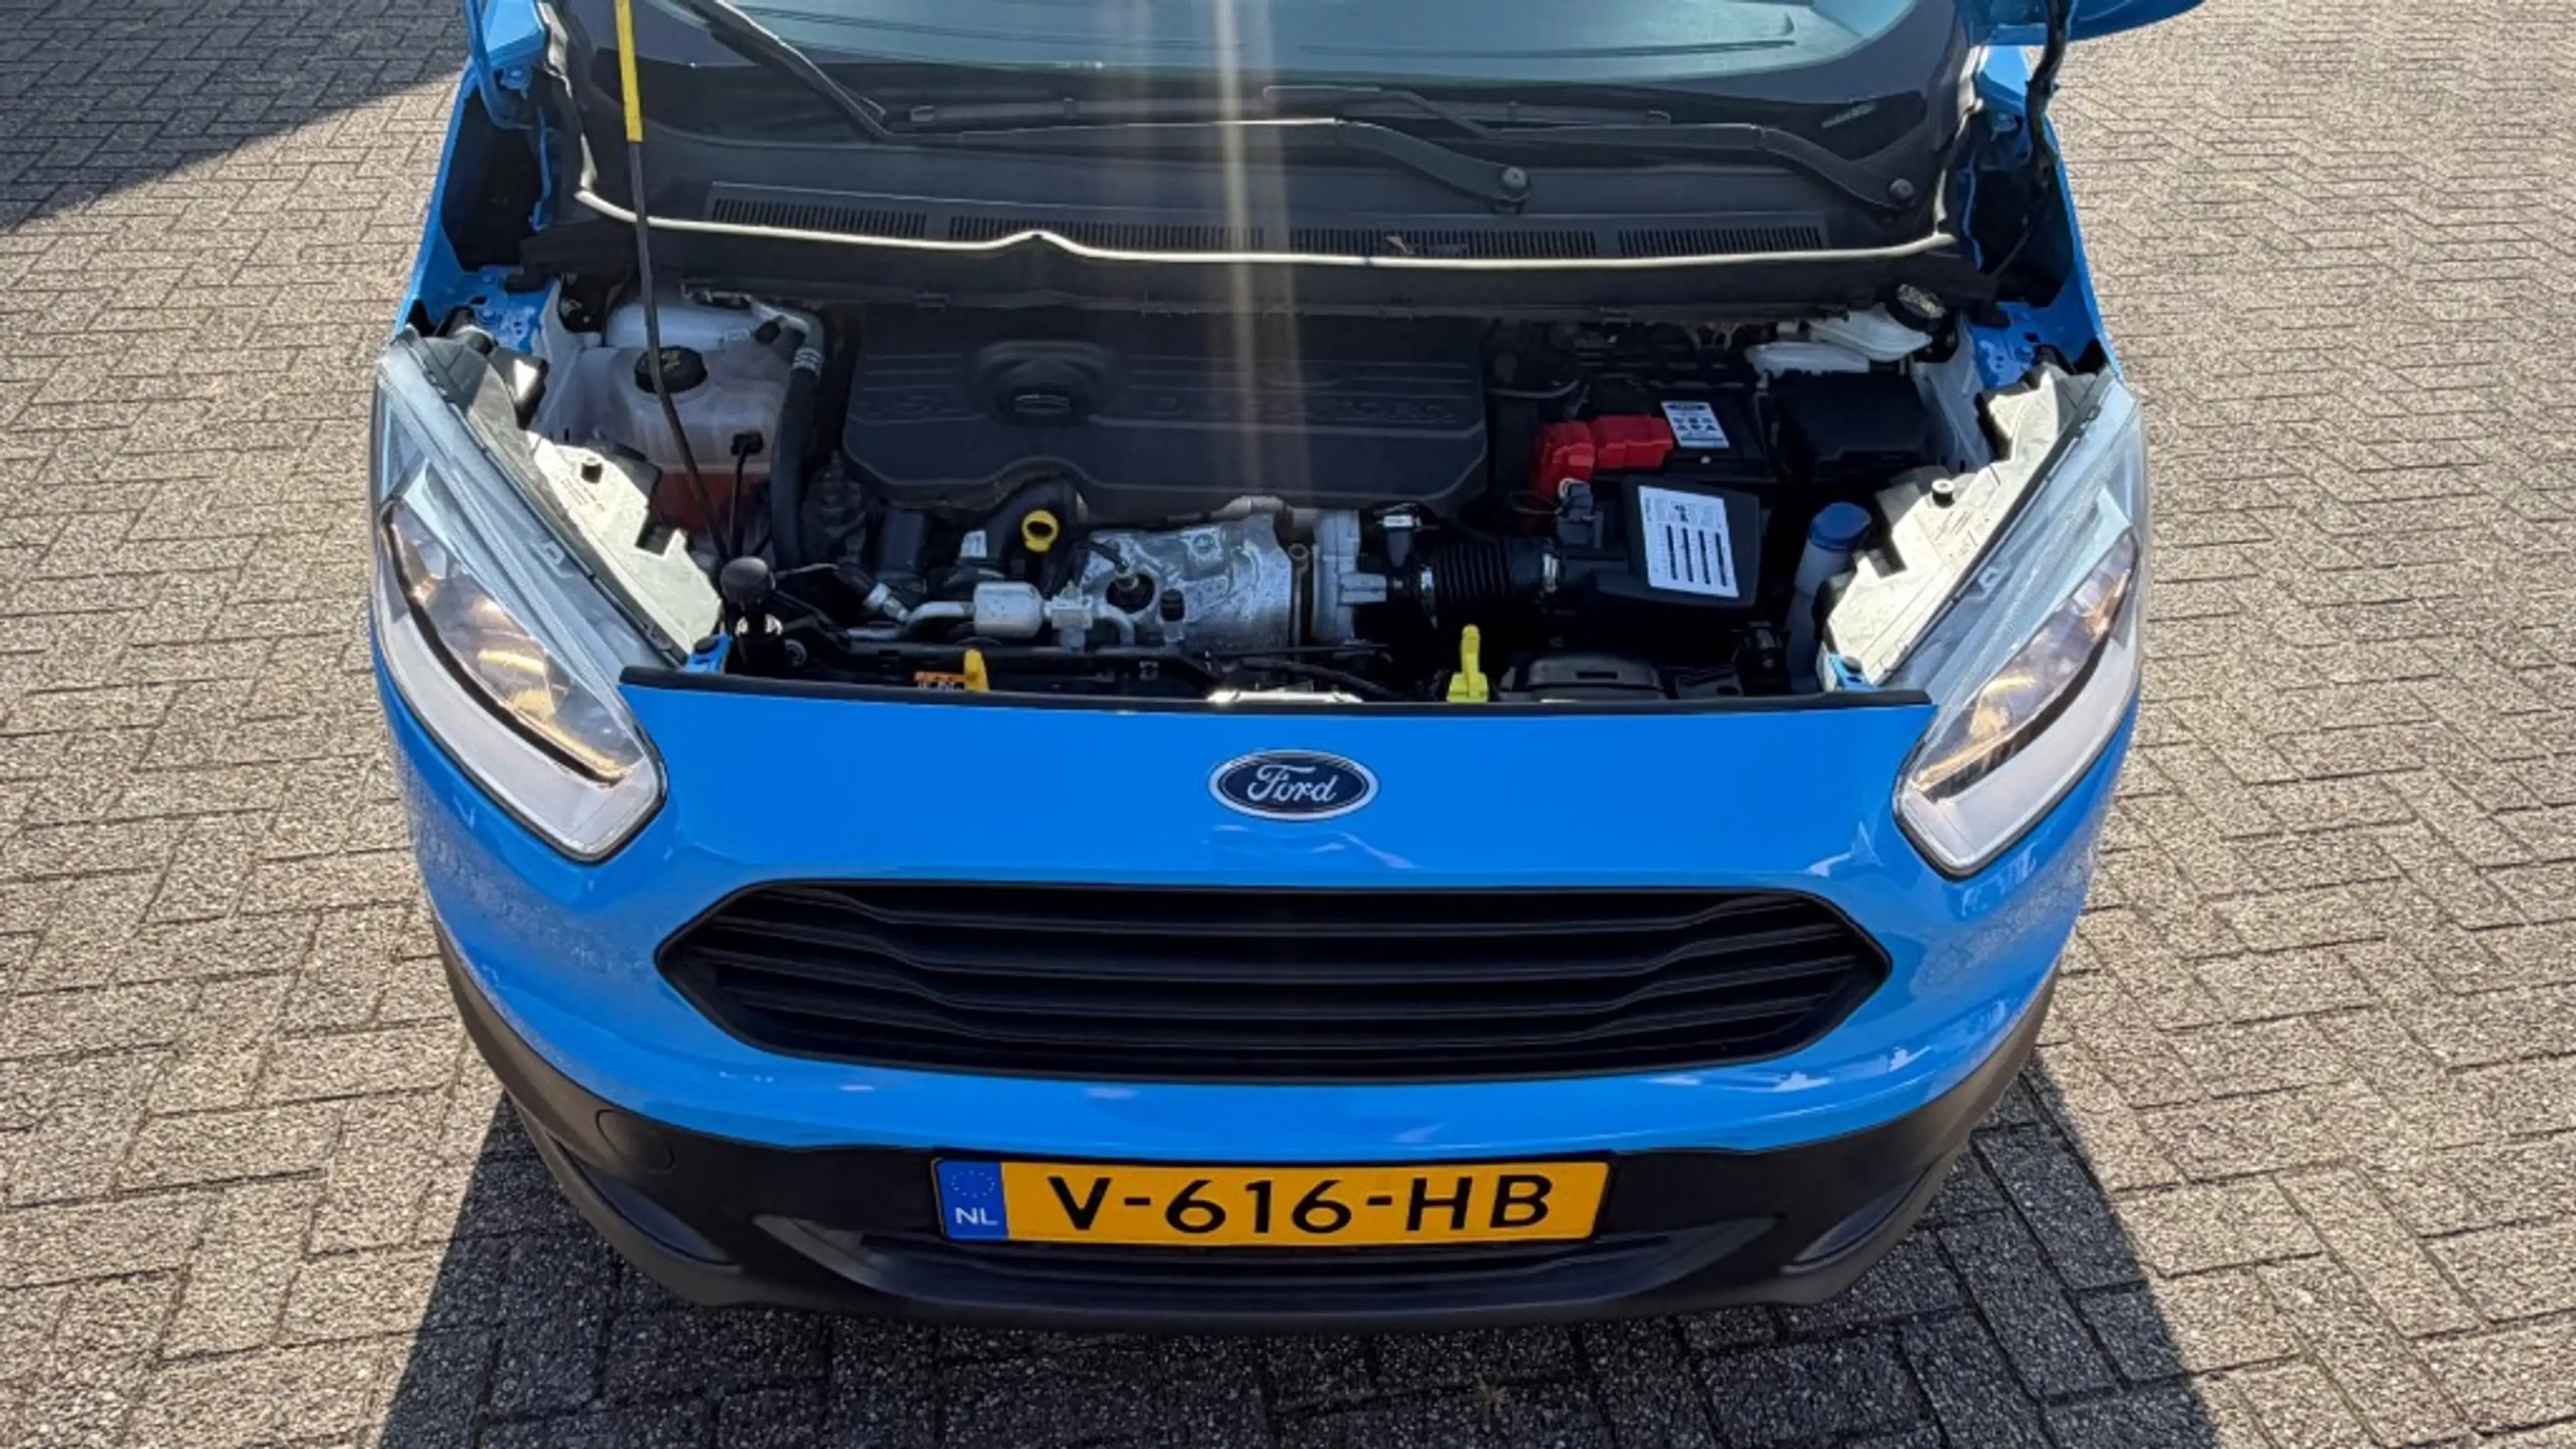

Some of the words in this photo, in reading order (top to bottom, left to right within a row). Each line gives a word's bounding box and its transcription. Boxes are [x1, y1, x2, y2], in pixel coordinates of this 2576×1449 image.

[1246, 763, 1339, 802] Ford
[955, 1207, 999, 1225] NL
[1047, 1174, 1553, 1234] V-616-HB
